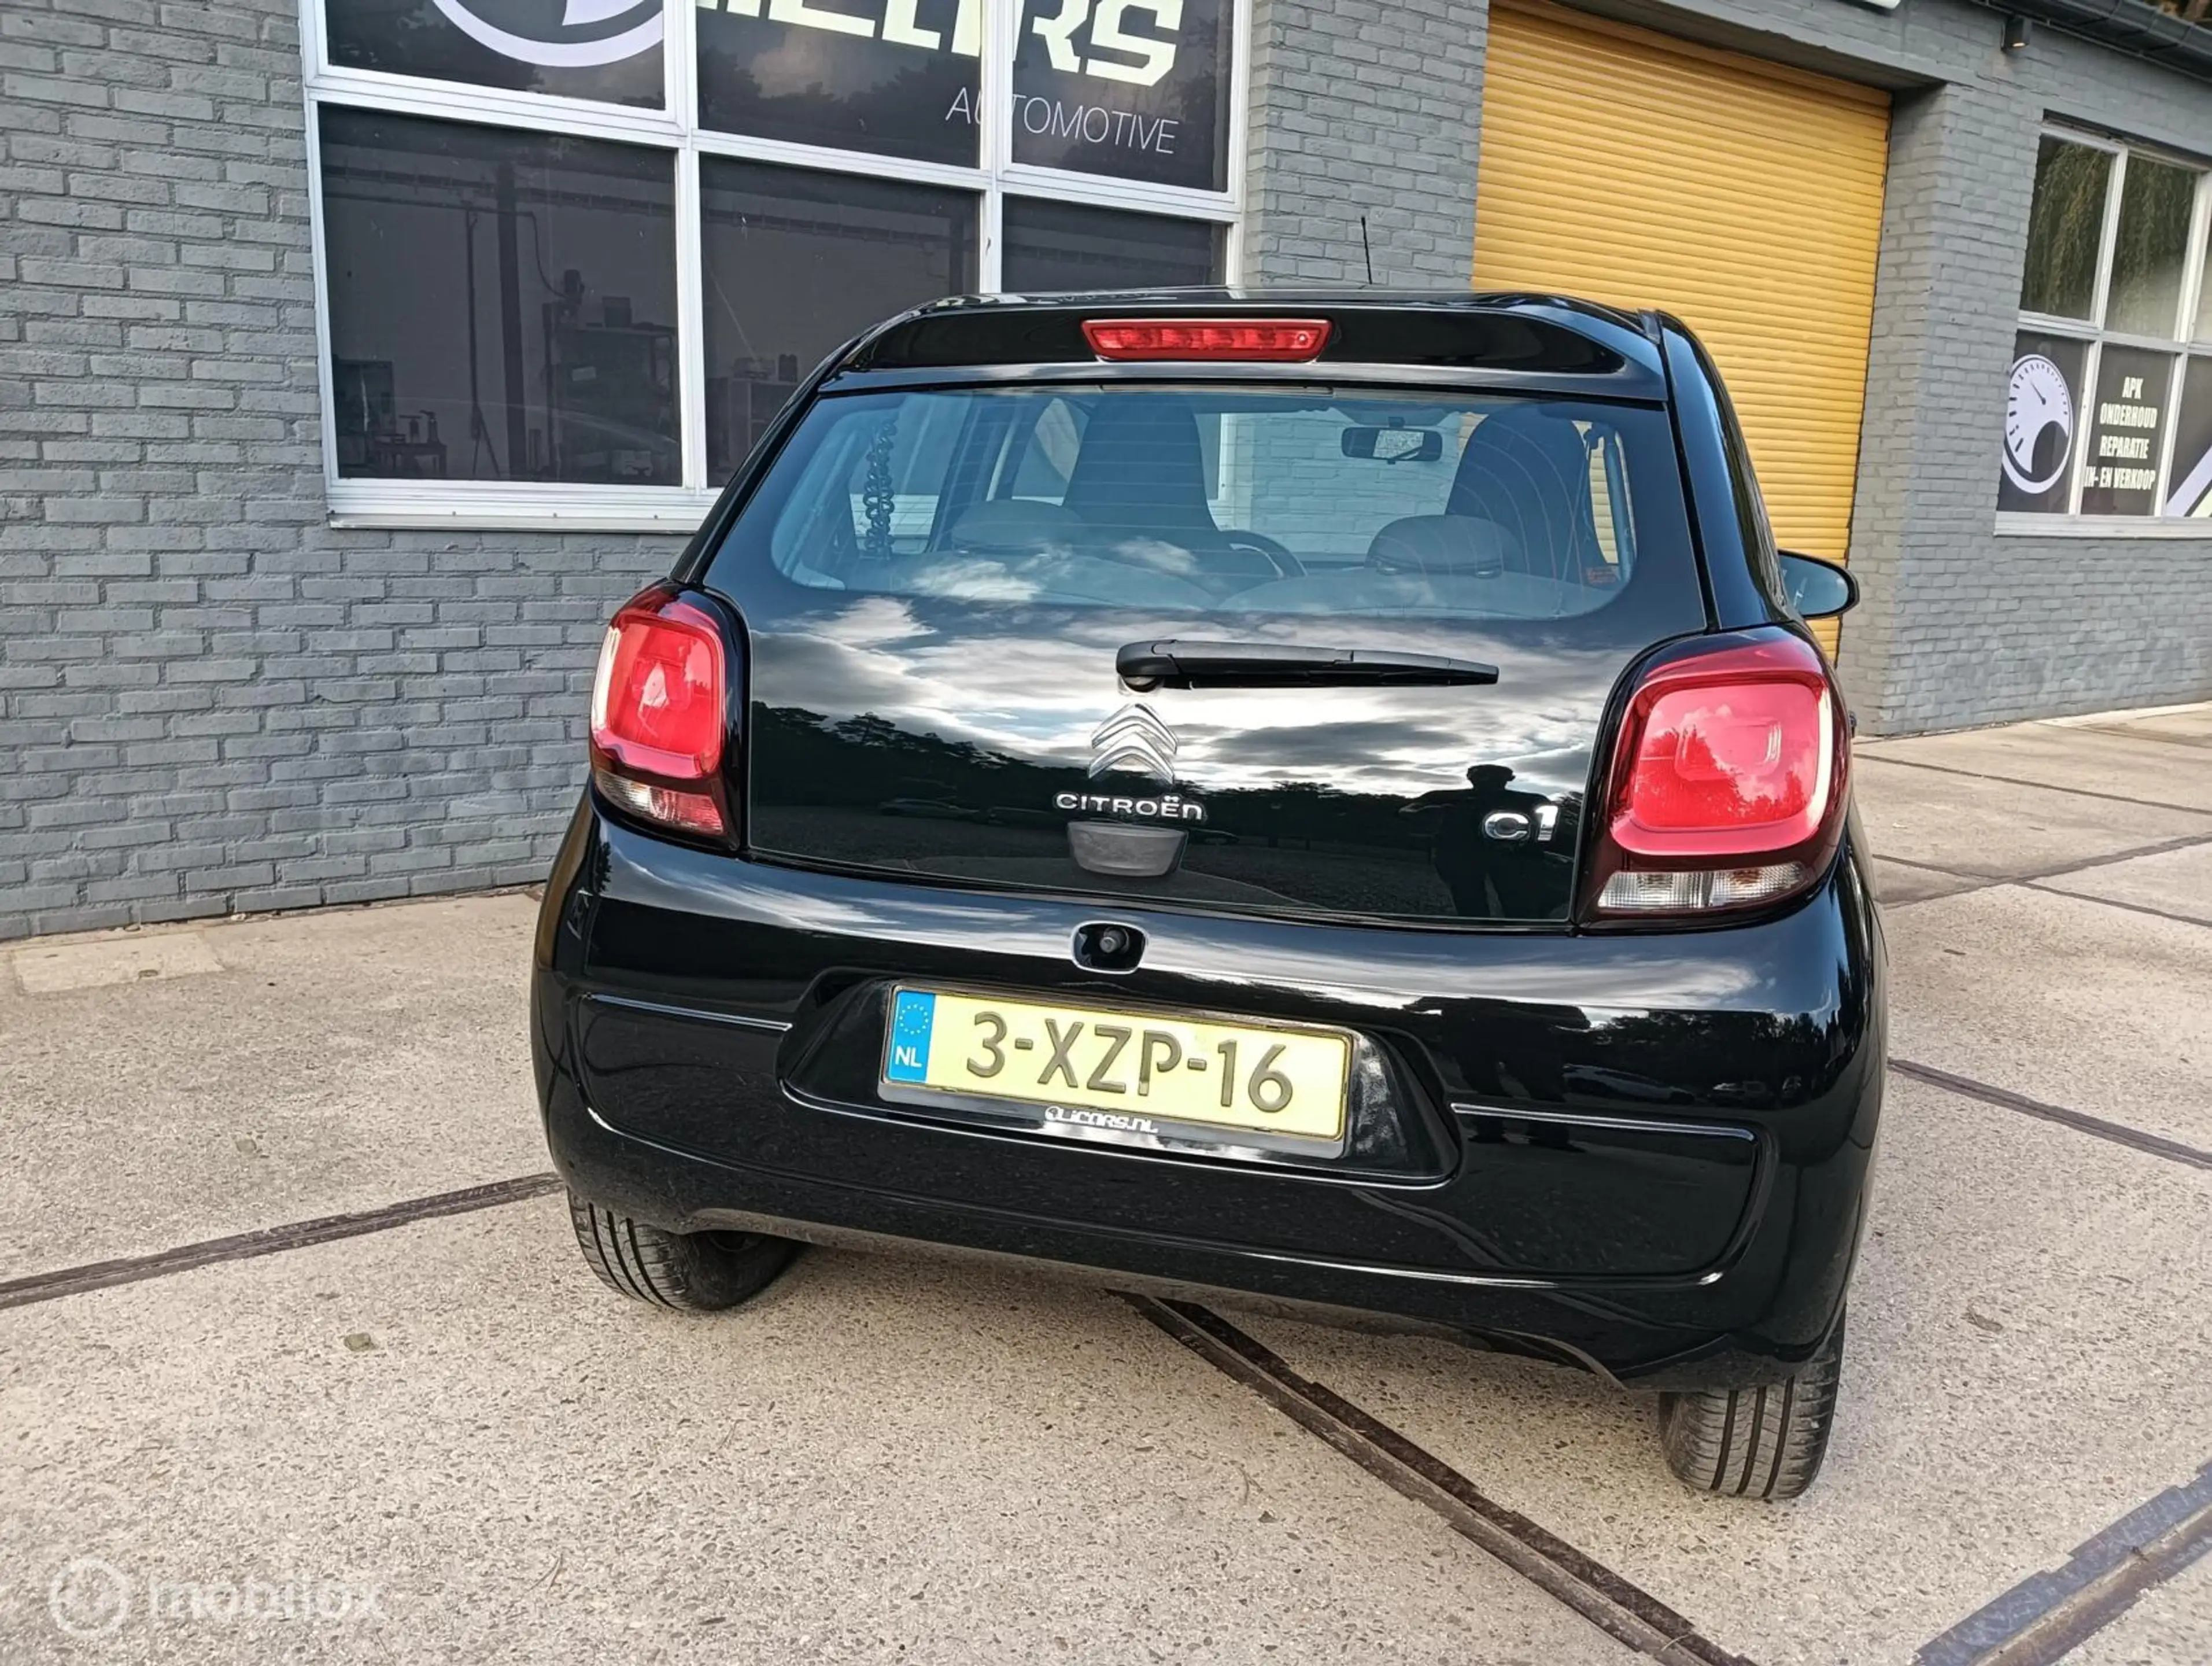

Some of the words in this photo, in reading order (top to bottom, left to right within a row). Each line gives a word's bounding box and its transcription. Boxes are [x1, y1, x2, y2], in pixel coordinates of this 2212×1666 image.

[2122, 376, 2144, 399] APK
[2100, 402, 2158, 429] ONDERHOUD
[2099, 435, 2150, 459] REPARATIE
[2099, 466, 2114, 487] EN
[2113, 467, 2156, 491] VERKOOP
[1484, 805, 1559, 842] C1
[895, 1045, 922, 1068] NL
[966, 1011, 1294, 1112] 3-XZP-16
